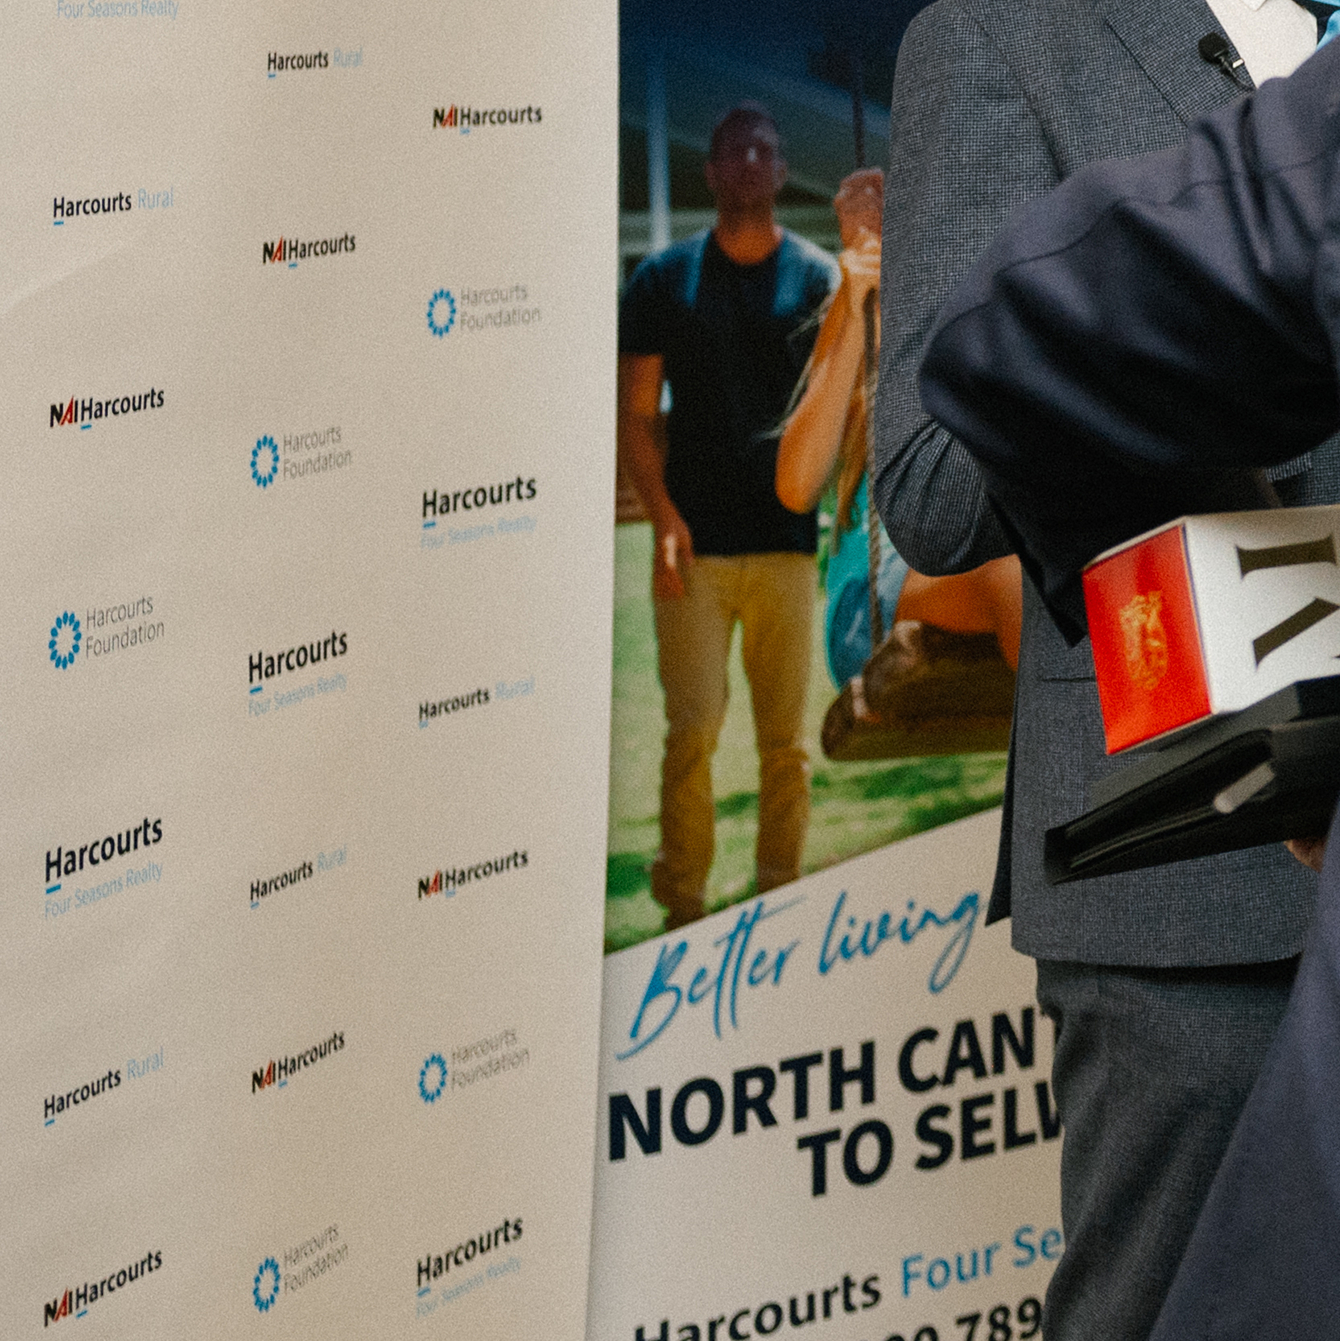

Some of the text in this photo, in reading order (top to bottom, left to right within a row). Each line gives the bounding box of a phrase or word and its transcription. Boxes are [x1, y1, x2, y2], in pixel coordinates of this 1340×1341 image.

[267, 50, 329, 72] Harcourts
[460, 105, 542, 127] Harcourts
[53, 192, 132, 218] Harcourts
[288, 233, 356, 260] Harcourts
[80, 388, 165, 422] Harcourts
[422, 476, 537, 519] Harcourts
[249, 630, 348, 683] Harcourts
[419, 686, 490, 722] Harcourts
[45, 817, 162, 882] Harcourts
[444, 849, 528, 890] Harcourts
[249, 861, 313, 902] Harcourts
[616, 891, 983, 1060] Better living
[278, 1031, 345, 1079] Harcourts
[44, 1068, 121, 1120] Harcourts
[607, 1006, 1050, 1162] NORTH CAN
[797, 1119, 894, 1197] TO
[417, 1216, 523, 1288] Harcourts
[900, 1242, 999, 1298] Four
[1013, 1224, 1063, 1268] Se
[74, 1249, 162, 1310] Harcourts
